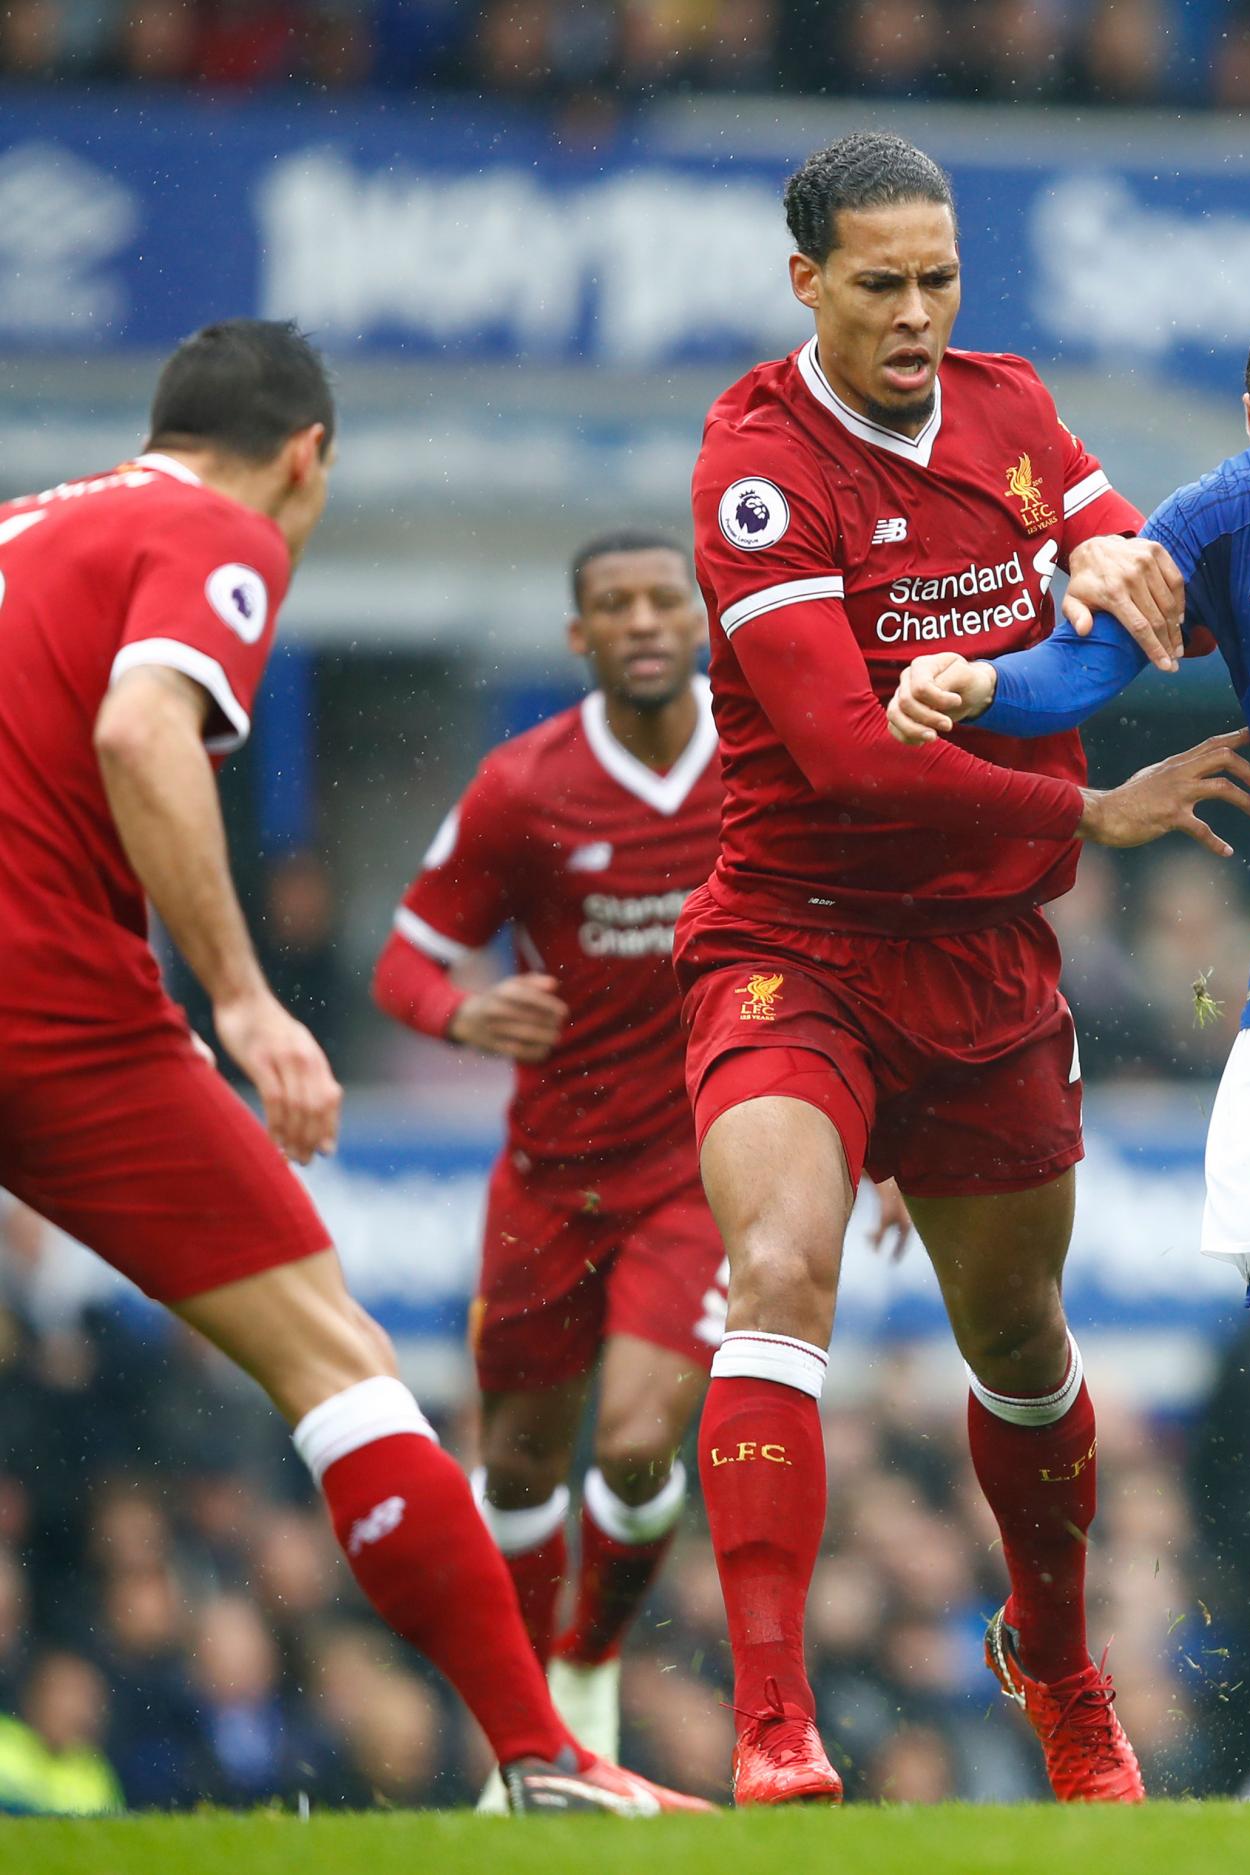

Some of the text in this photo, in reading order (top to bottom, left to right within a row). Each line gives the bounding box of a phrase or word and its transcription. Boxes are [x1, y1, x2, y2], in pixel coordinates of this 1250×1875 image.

[1037, 516, 1058, 529] YEARS
[889, 551, 1024, 604] Standard
[876, 589, 1036, 643] Chartered
[711, 1442, 793, 1467] L.F.C.
